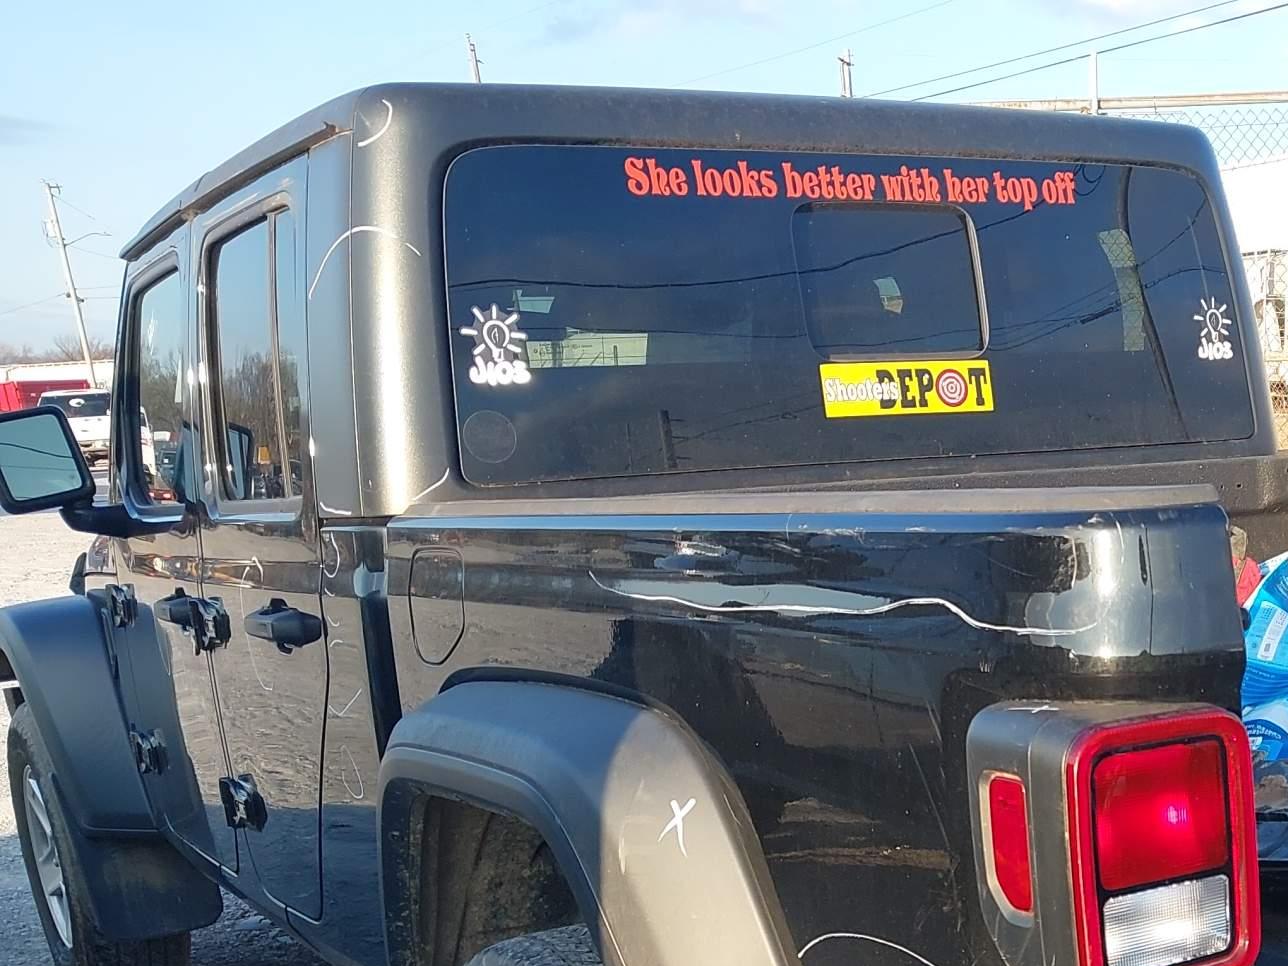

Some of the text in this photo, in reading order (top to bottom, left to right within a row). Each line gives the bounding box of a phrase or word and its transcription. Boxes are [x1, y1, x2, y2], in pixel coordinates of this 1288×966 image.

[624, 156, 1075, 211] She looks better with her top off
[824, 367, 988, 409] Shooters DEPOT
